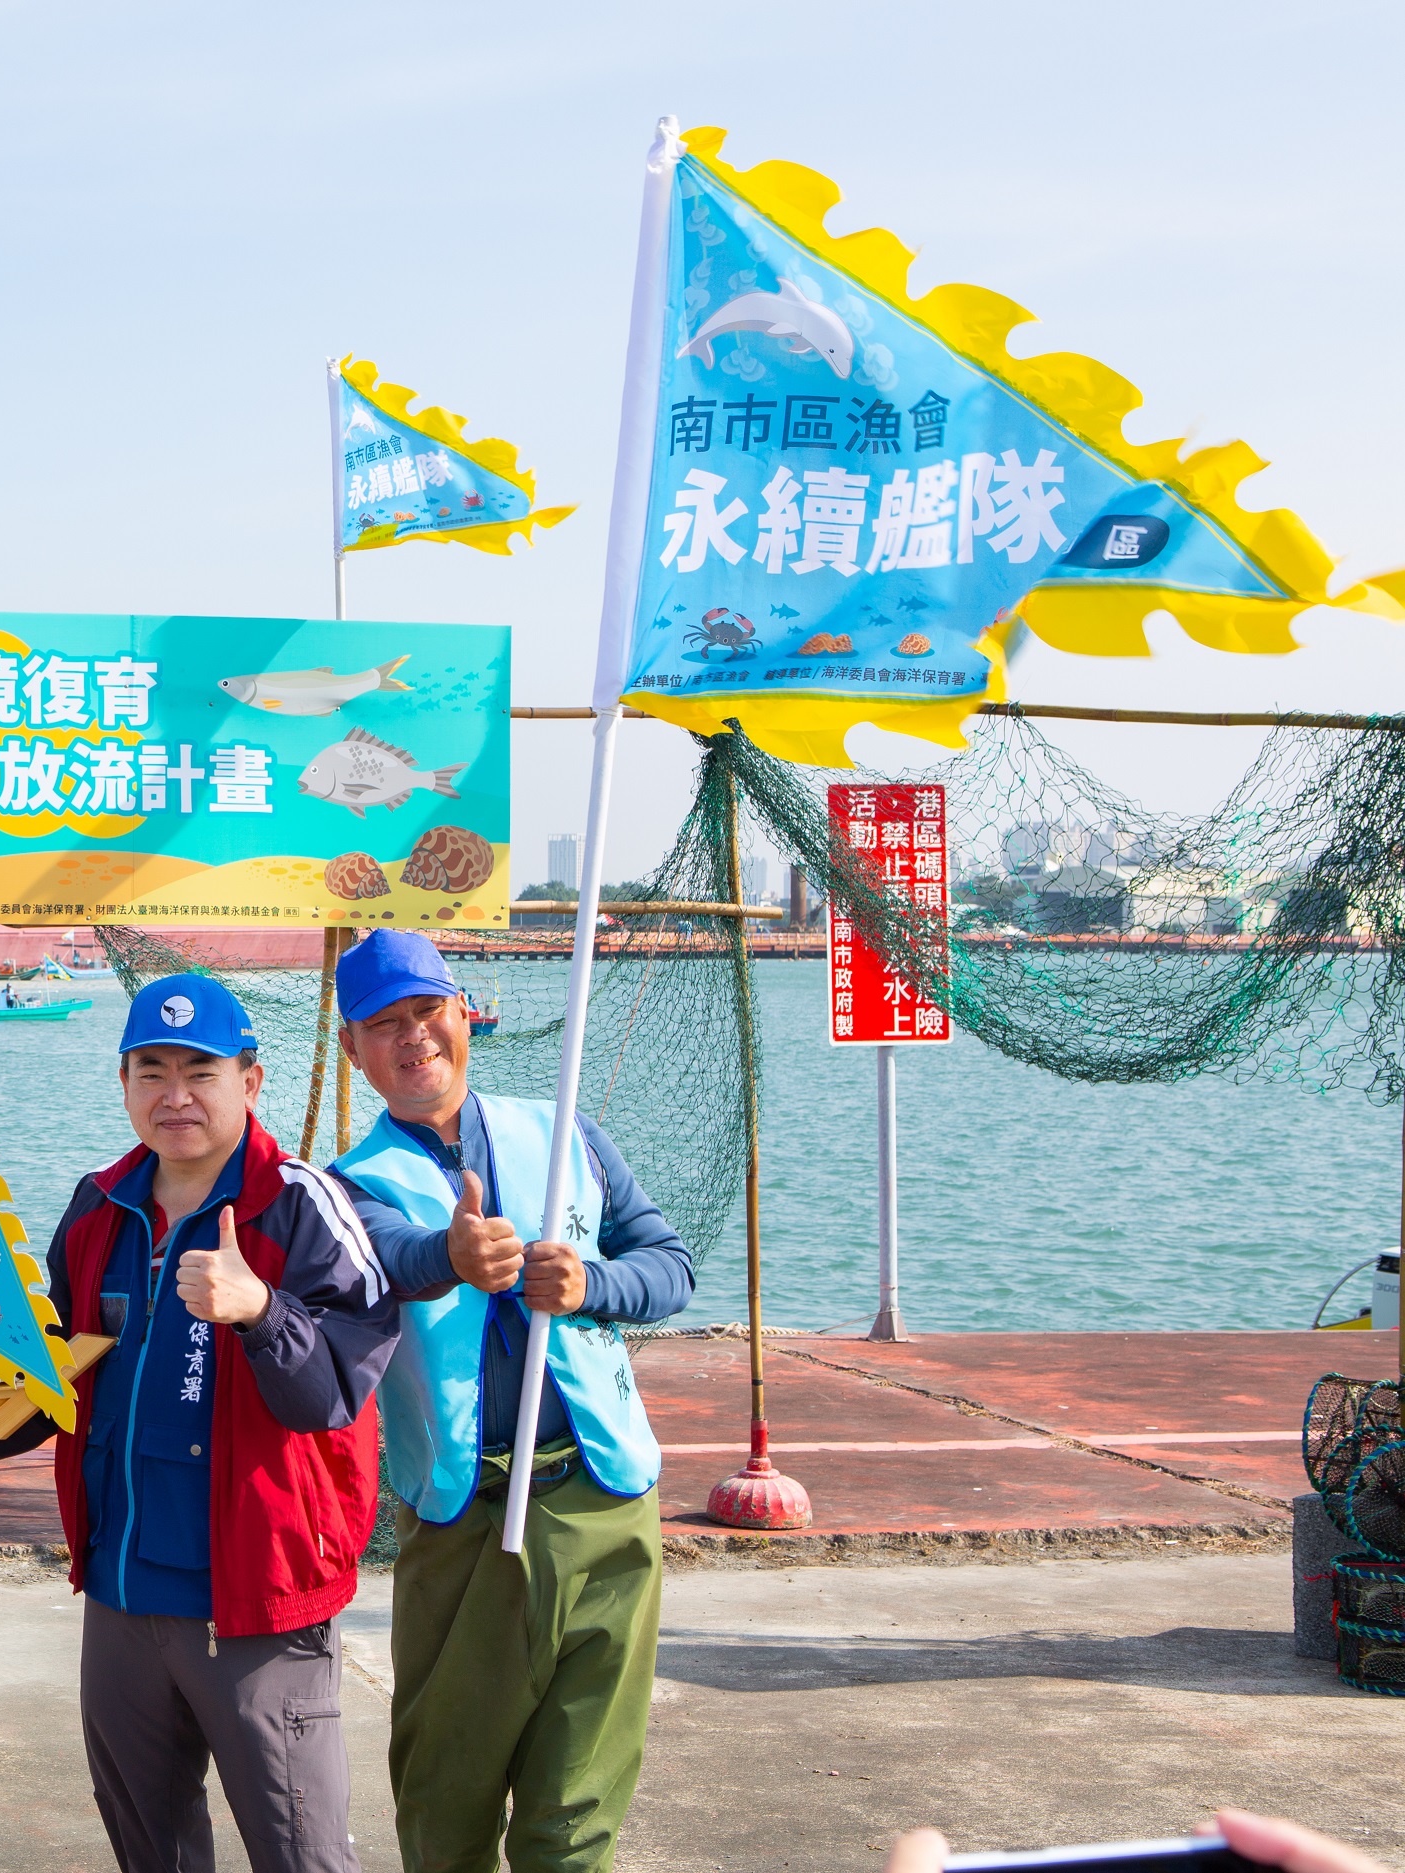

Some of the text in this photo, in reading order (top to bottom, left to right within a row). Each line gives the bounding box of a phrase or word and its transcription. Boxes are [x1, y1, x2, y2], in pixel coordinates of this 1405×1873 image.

[344, 434, 403, 472] 南市區漁會
[669, 388, 951, 456] 南市區漁會
[348, 449, 454, 510] 永續艦隊
[658, 447, 1068, 578] 永續艦隊
[180, 1321, 209, 1403] 保育署
